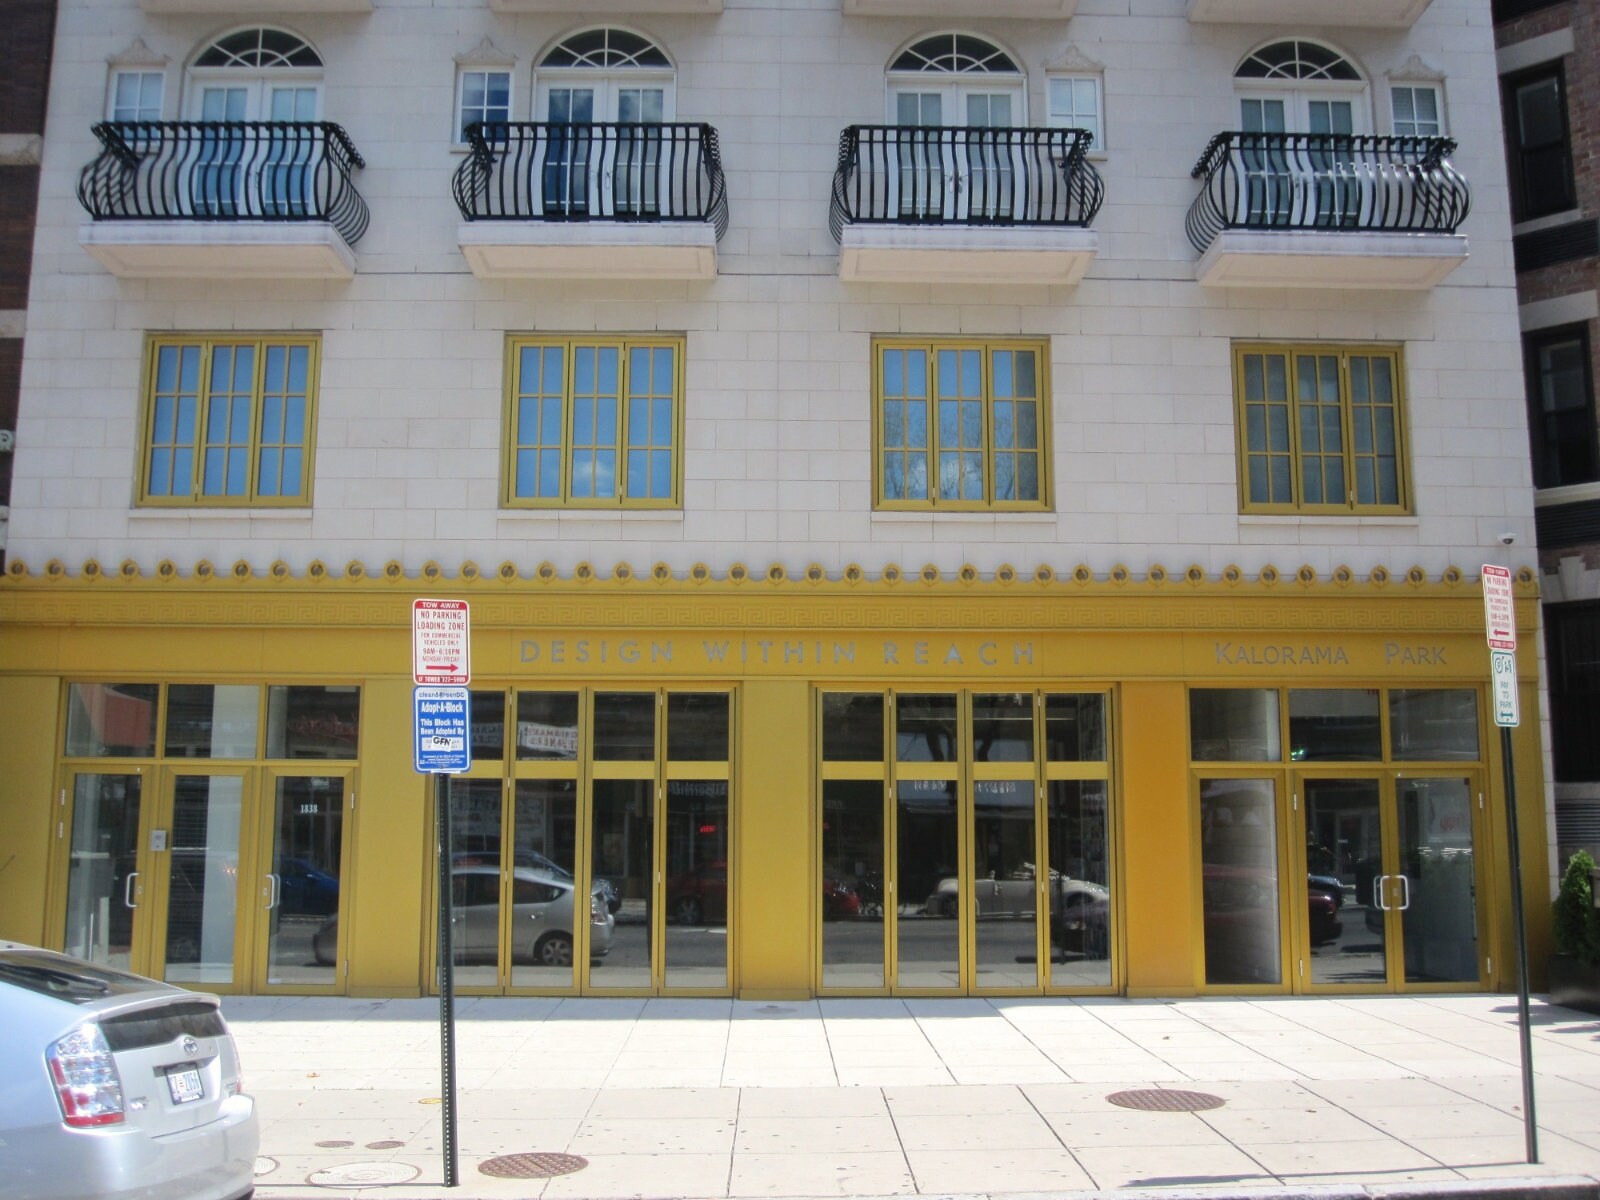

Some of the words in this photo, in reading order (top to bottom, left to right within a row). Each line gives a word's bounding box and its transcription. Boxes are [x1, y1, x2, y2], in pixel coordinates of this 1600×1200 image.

[421, 611, 430, 619] NO
[433, 611, 461, 620] PARKING
[417, 622, 445, 630] LOADING
[449, 622, 465, 631] ZONE
[520, 640, 673, 663] DESIGN
[703, 640, 856, 664] WITHIN
[884, 641, 1034, 665] REACH
[1215, 642, 1350, 665] KALORAMA
[1385, 640, 1448, 665] PARK
[421, 702, 463, 715] Adopt-A-Block
[457, 728, 464, 736] By
[300, 804, 318, 814] 1838
